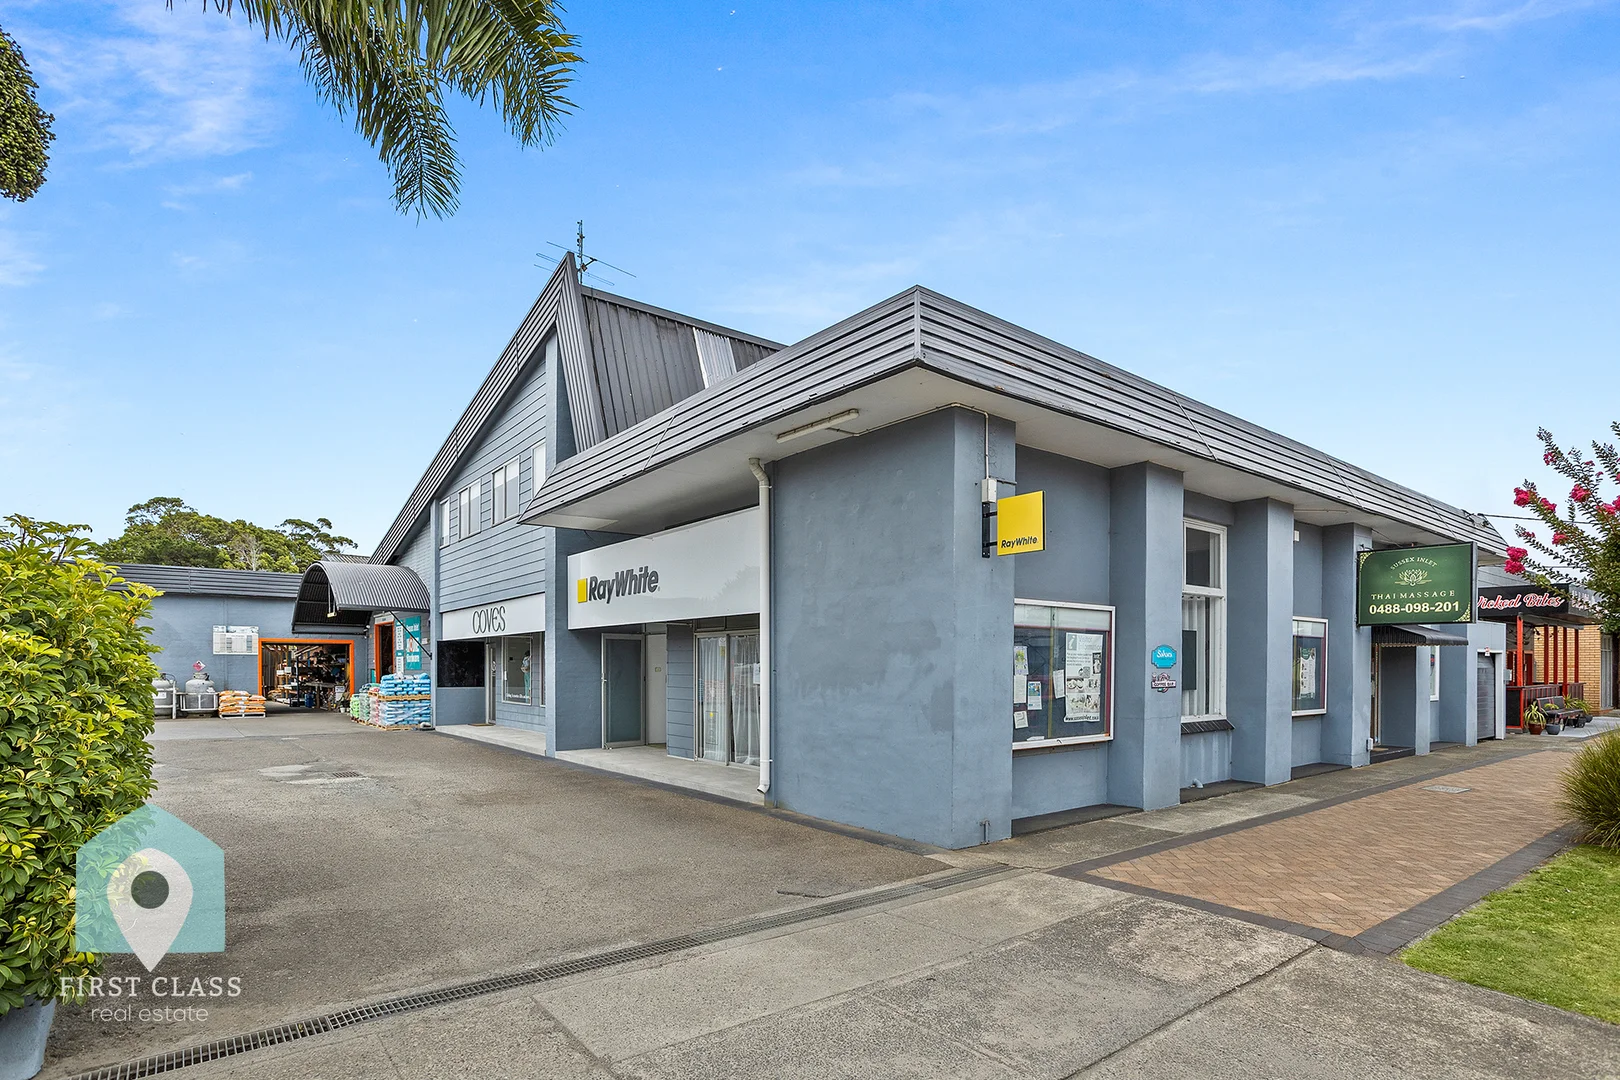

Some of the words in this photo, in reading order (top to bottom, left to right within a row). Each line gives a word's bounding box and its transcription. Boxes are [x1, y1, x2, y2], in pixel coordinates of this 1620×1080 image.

[1390, 556, 1415, 570] SUSSEX
[1416, 556, 1438, 568] INLET
[1399, 589, 1455, 599] MASSAGE
[1523, 592, 1565, 607] Bites
[1369, 601, 1460, 614] 0488-098-201
